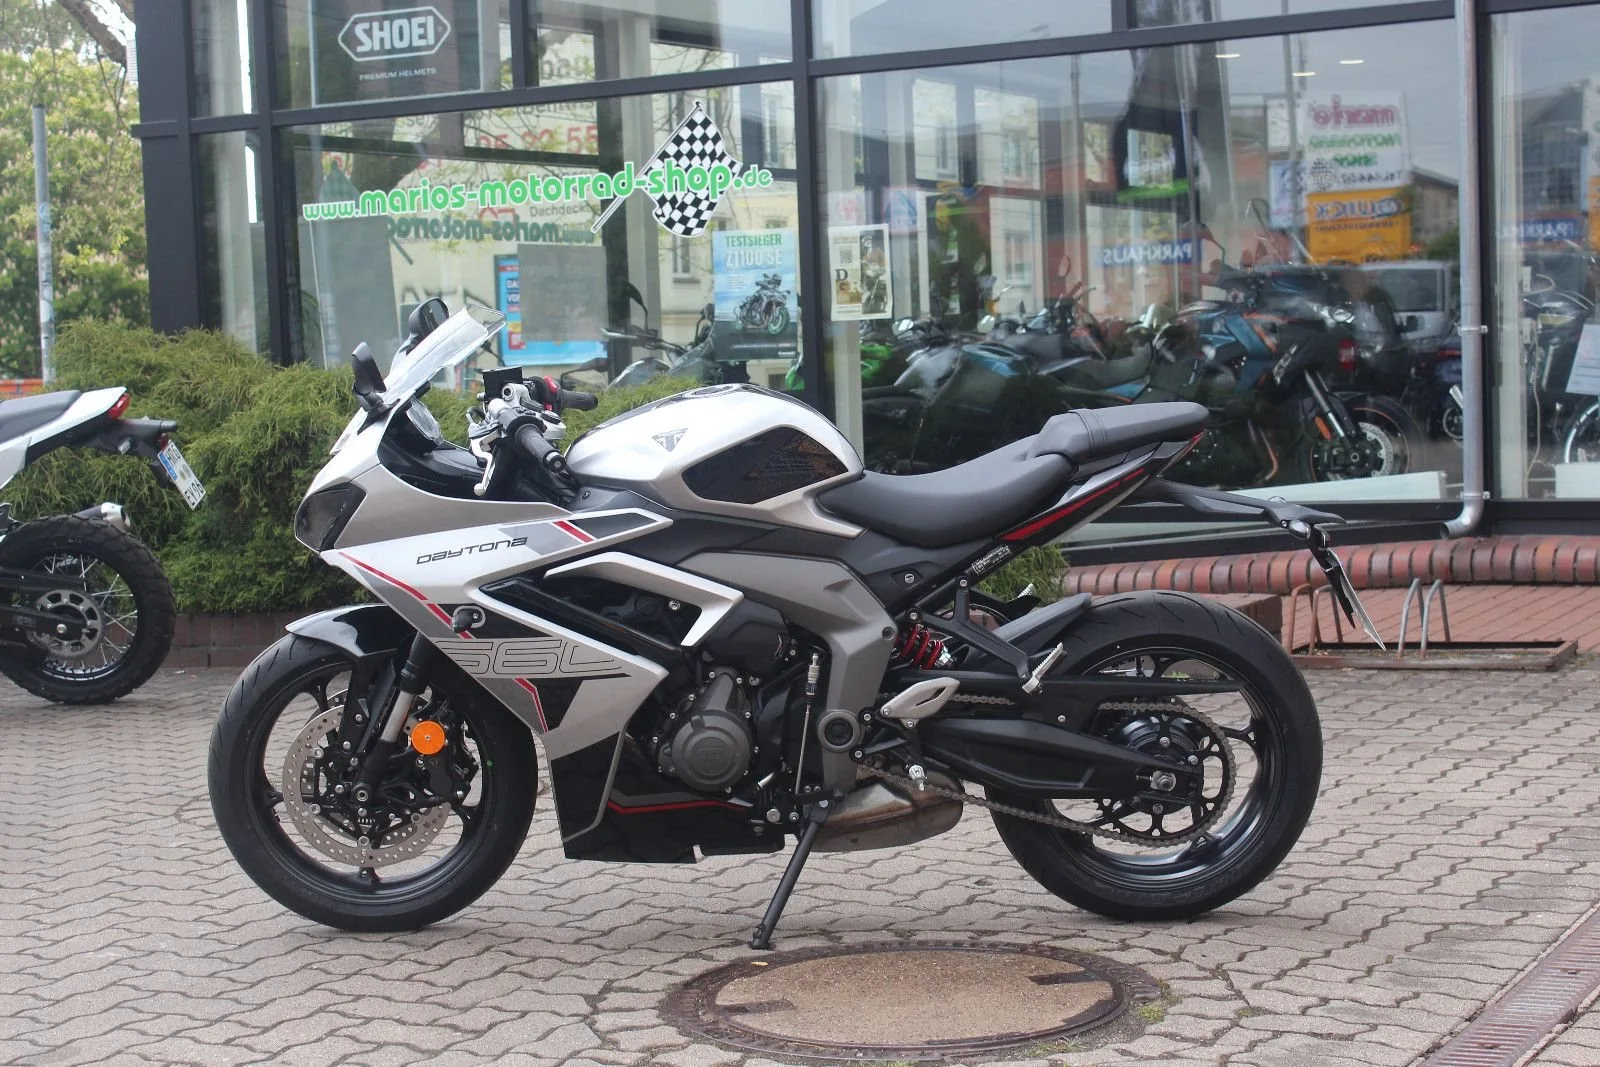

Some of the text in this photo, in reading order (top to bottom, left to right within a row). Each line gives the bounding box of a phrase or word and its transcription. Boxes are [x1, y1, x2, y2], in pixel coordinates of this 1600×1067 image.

[354, 15, 435, 53] SHOEI
[359, 67, 437, 81] PREMIUM HELMETS
[302, 158, 773, 221] www.marios-motorrad-shop.de
[725, 233, 782, 248] TESTSIEGER
[767, 247, 783, 266] SE
